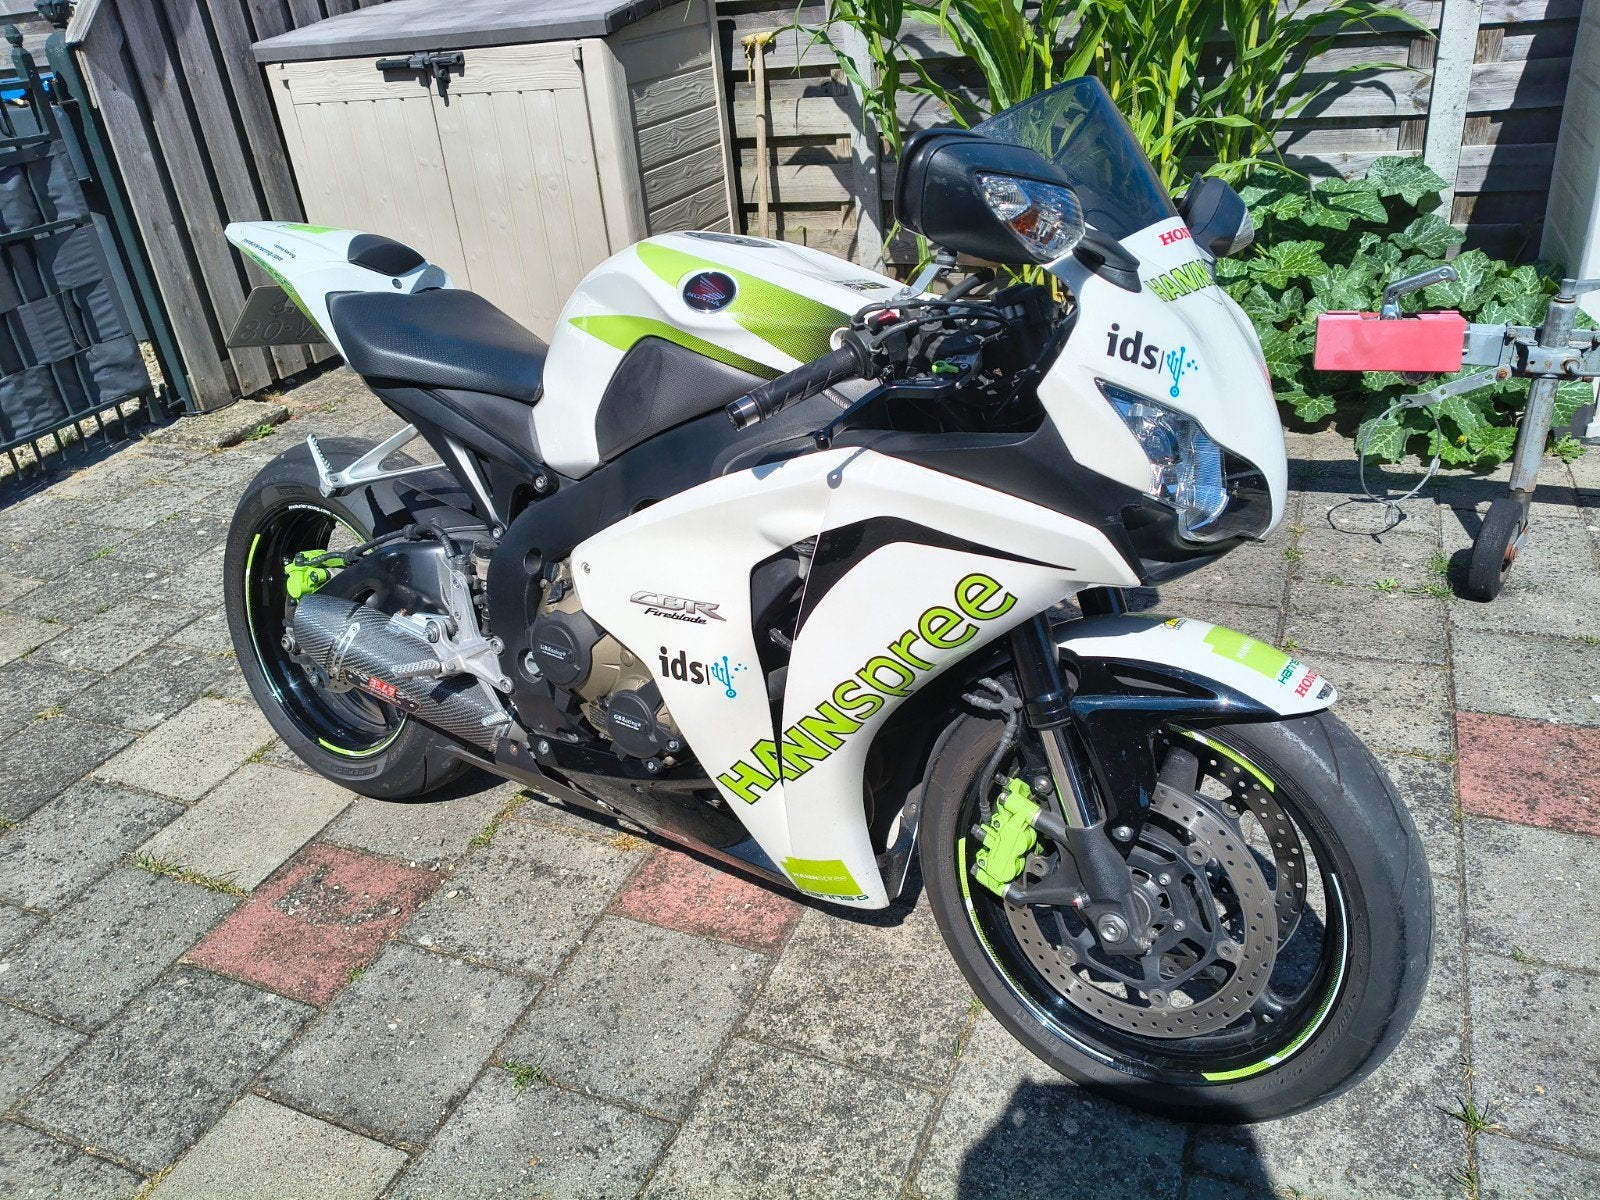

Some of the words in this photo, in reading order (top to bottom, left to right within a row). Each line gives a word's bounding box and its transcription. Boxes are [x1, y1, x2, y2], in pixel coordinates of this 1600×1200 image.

[1107, 323, 1160, 370] ids
[630, 590, 727, 622] CBR
[644, 608, 707, 625] Fireblade
[659, 646, 705, 685] ids
[716, 573, 1018, 804] HANNspree
